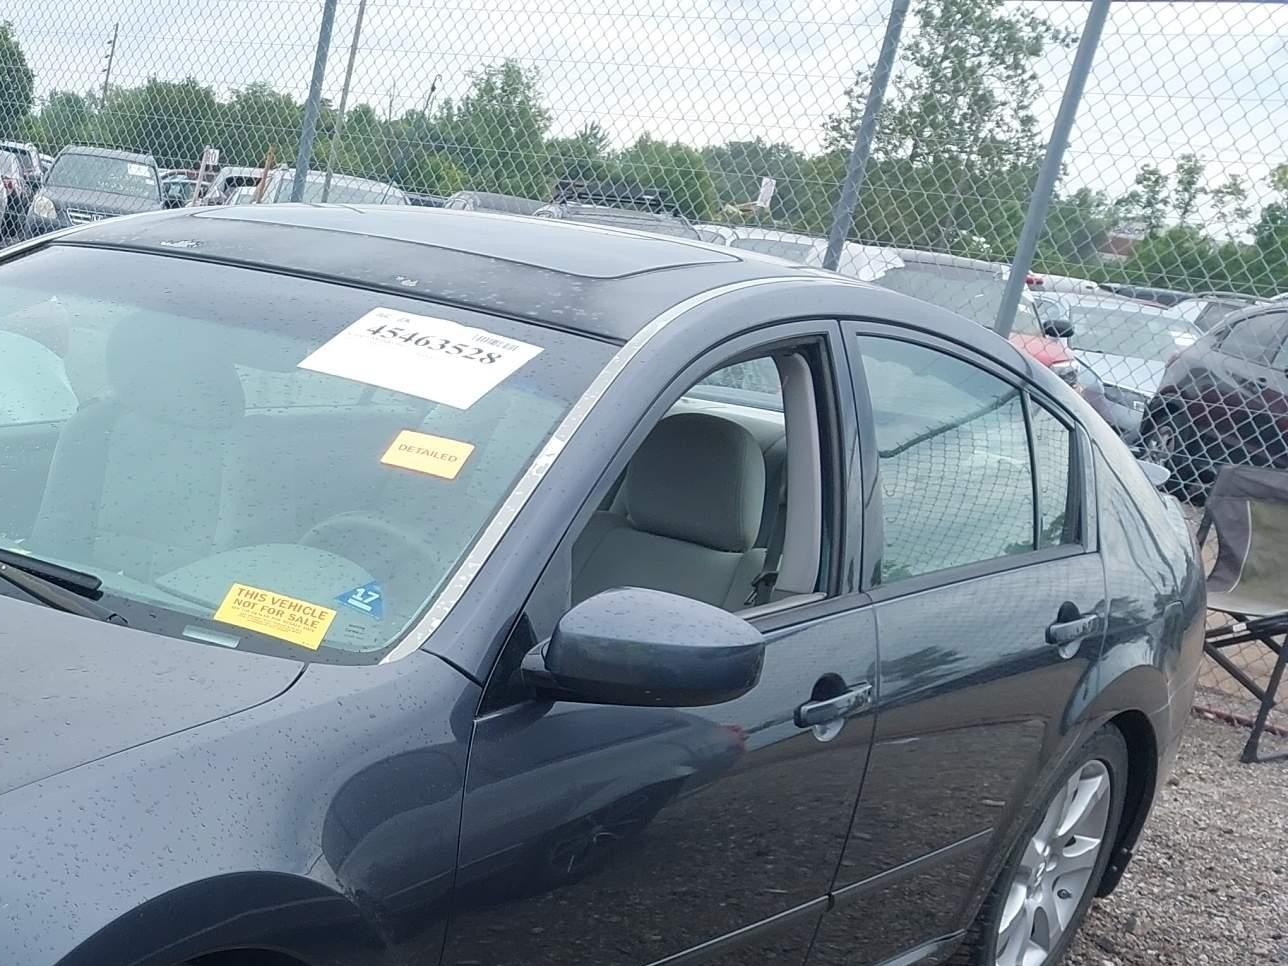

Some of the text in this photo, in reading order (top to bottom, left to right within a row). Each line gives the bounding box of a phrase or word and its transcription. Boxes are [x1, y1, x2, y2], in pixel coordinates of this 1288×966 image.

[366, 325, 502, 364] 45463528
[398, 443, 458, 463] DETAILED
[232, 598, 258, 611] NOT
[260, 604, 286, 618] FOR
[287, 612, 321, 629] SALE
[237, 588, 267, 603] THIS
[272, 598, 328, 620] VEHICLE
